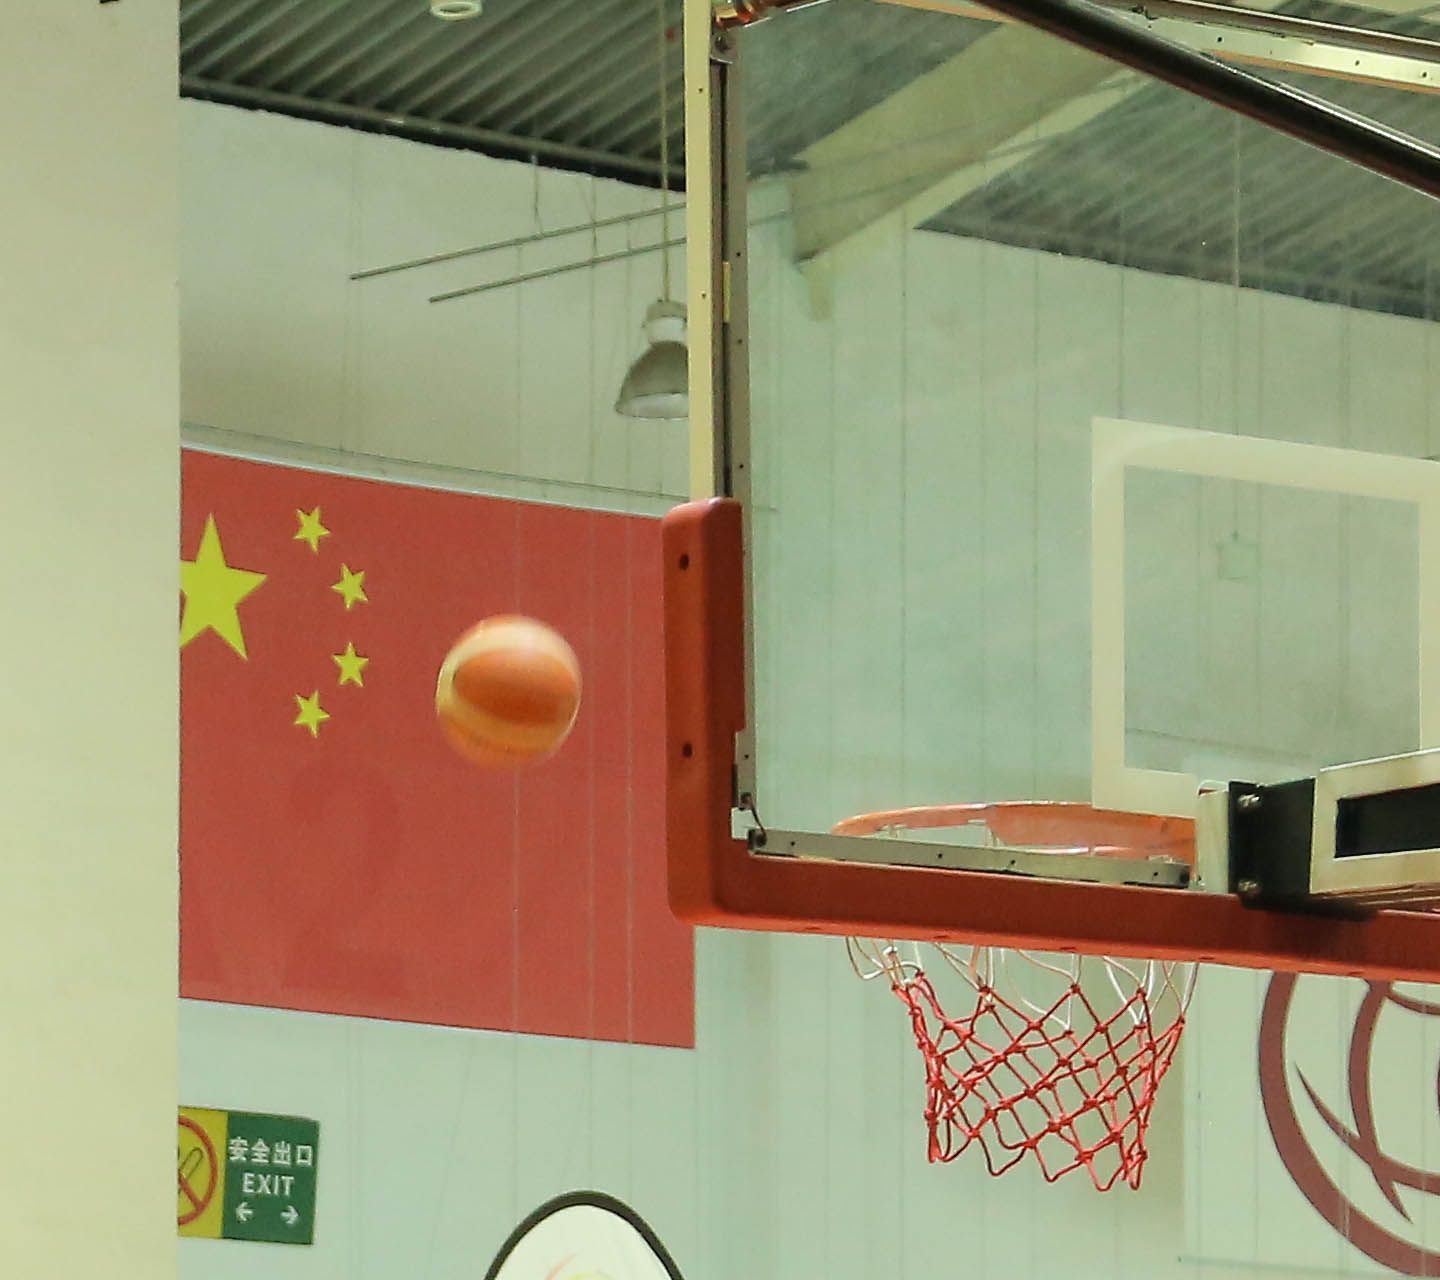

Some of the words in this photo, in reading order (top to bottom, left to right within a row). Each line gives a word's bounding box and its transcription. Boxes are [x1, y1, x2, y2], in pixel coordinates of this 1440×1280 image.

[228, 1136, 313, 1166] 安全出口
[242, 1172, 294, 1196] EXIT
